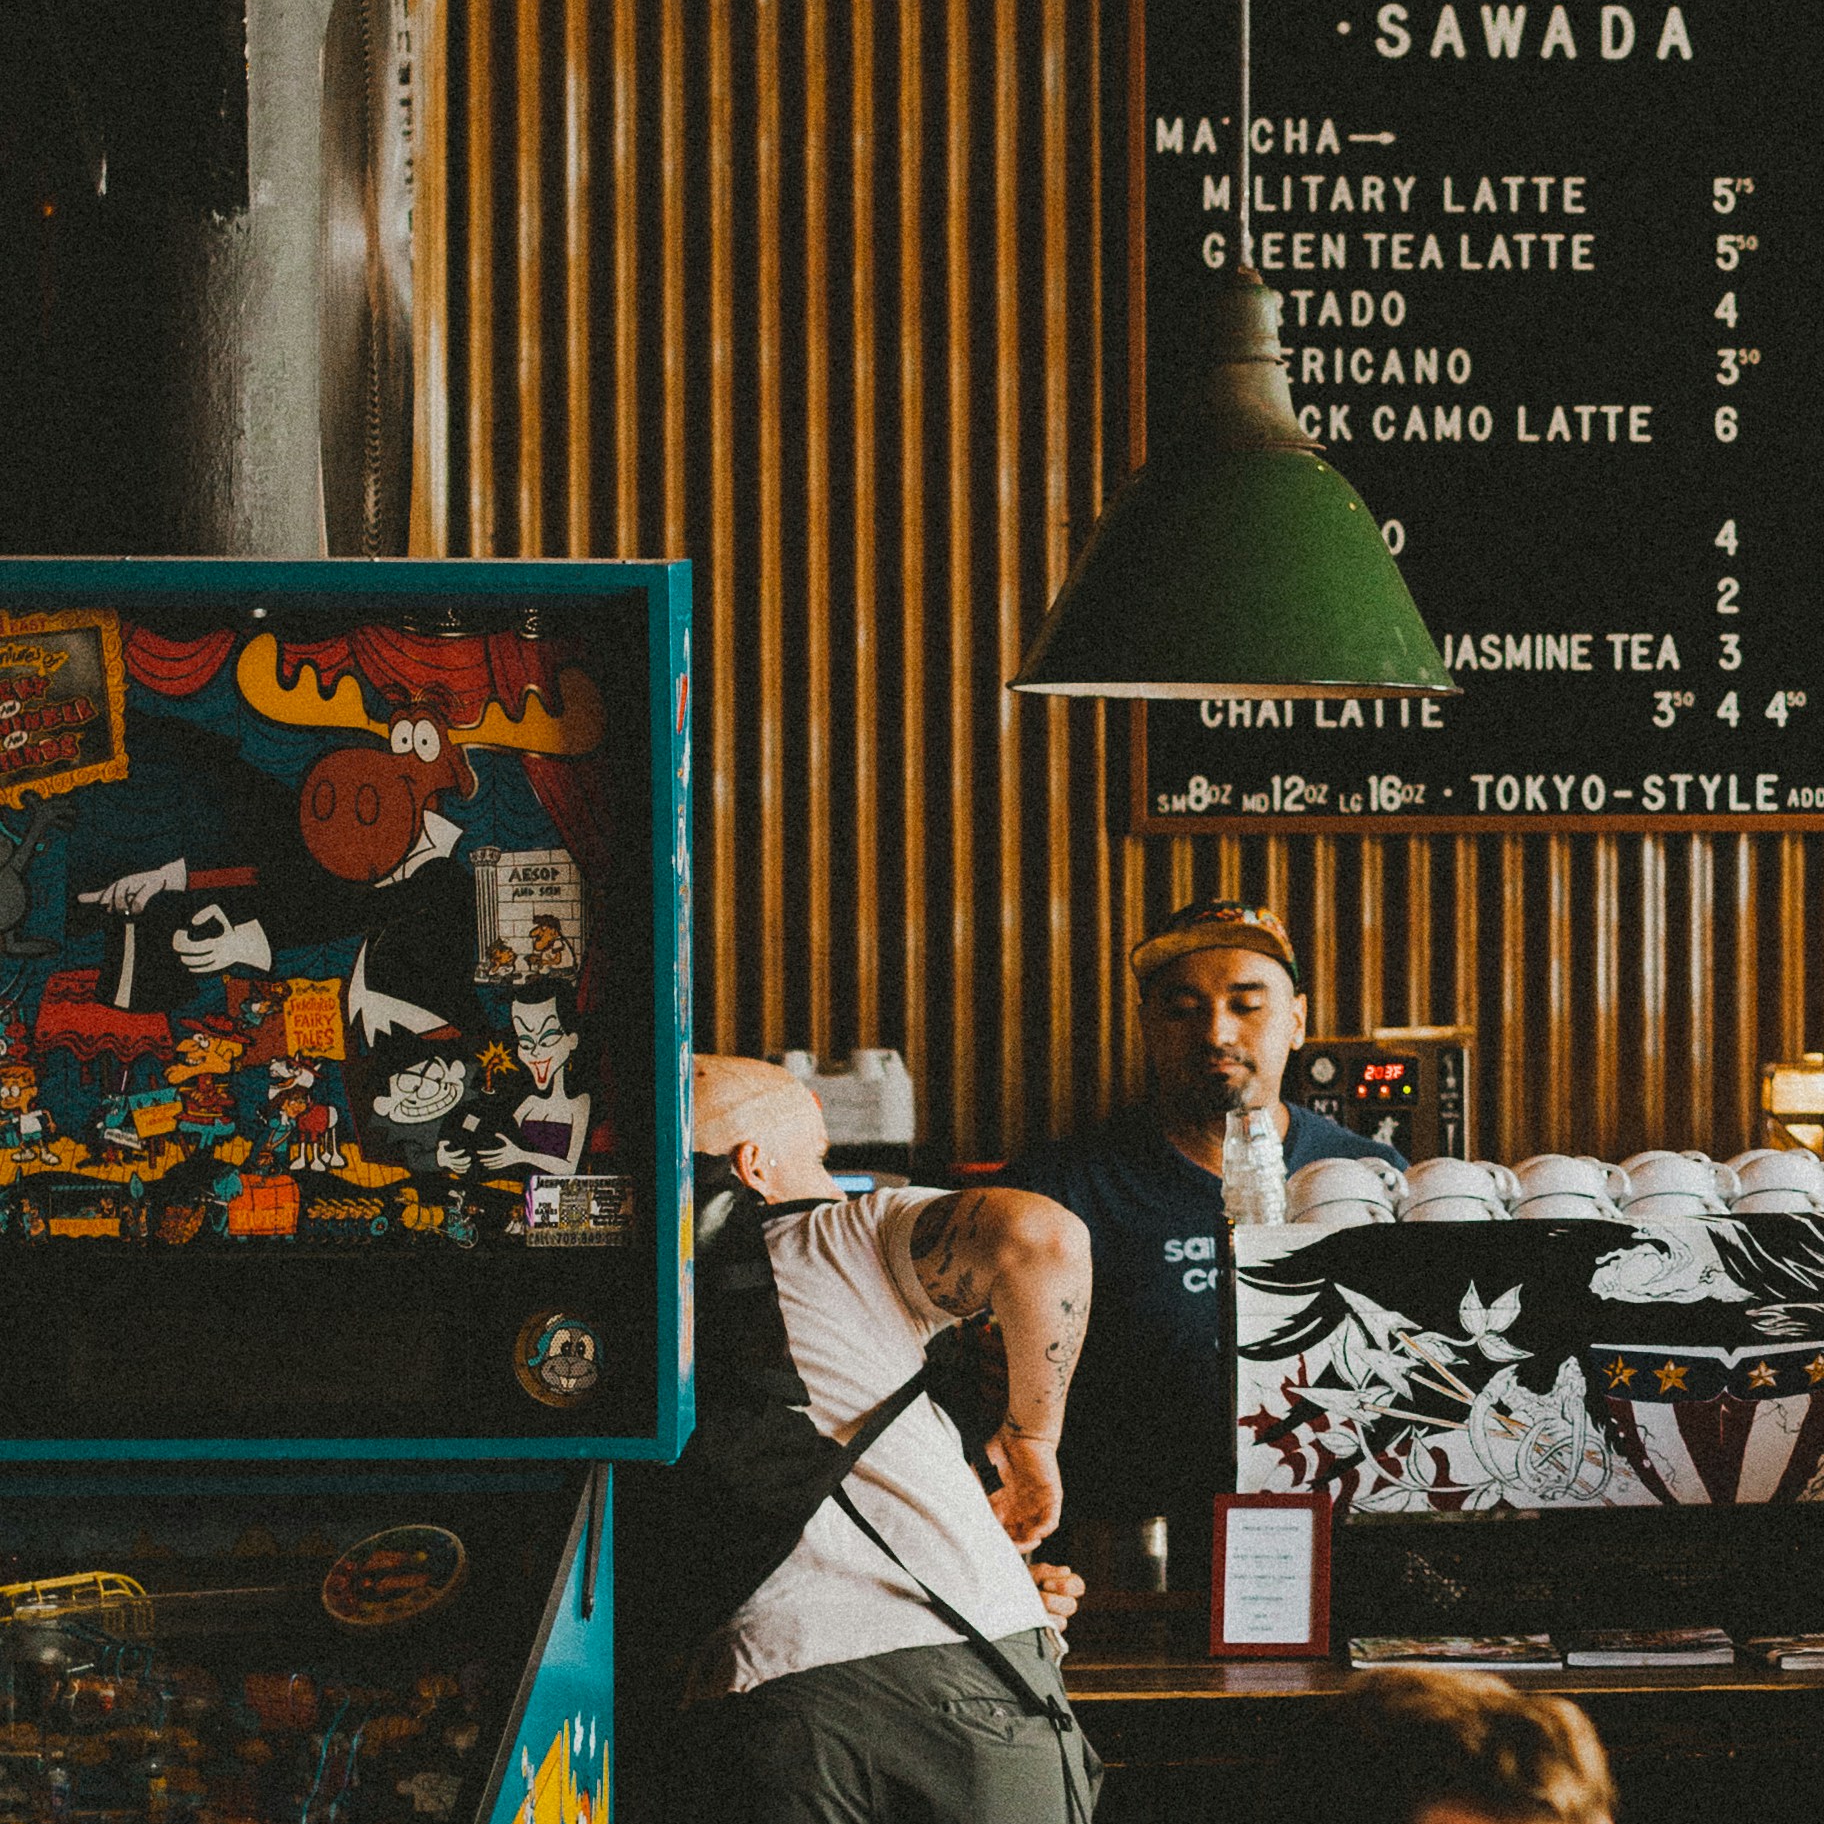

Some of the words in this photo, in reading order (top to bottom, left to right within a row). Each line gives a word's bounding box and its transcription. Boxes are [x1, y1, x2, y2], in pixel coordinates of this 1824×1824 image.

[1375, 3, 1693, 60] SAWADA
[1156, 115, 1340, 154] MACHA
[1203, 175, 1416, 213] MLITARY
[1443, 176, 1586, 214] LATTE
[1363, 233, 1444, 270] TEA
[1460, 233, 1595, 271] LATTE
[1714, 291, 1738, 328] 4
[1372, 405, 1493, 442] CAMO
[1517, 405, 1652, 443] LATTE
[1714, 405, 1738, 443] 6
[1714, 519, 1739, 556] 4
[1716, 576, 1740, 614] 2
[1606, 633, 1681, 671] TEA
[1718, 633, 1742, 671] 3
[1716, 691, 1740, 727] 4
[1470, 773, 1779, 812] TOKYO-STYLE
[508, 867, 561, 882] AESOP
[293, 1027, 335, 1046] TALES
[294, 1012, 337, 1028] FAIRY
